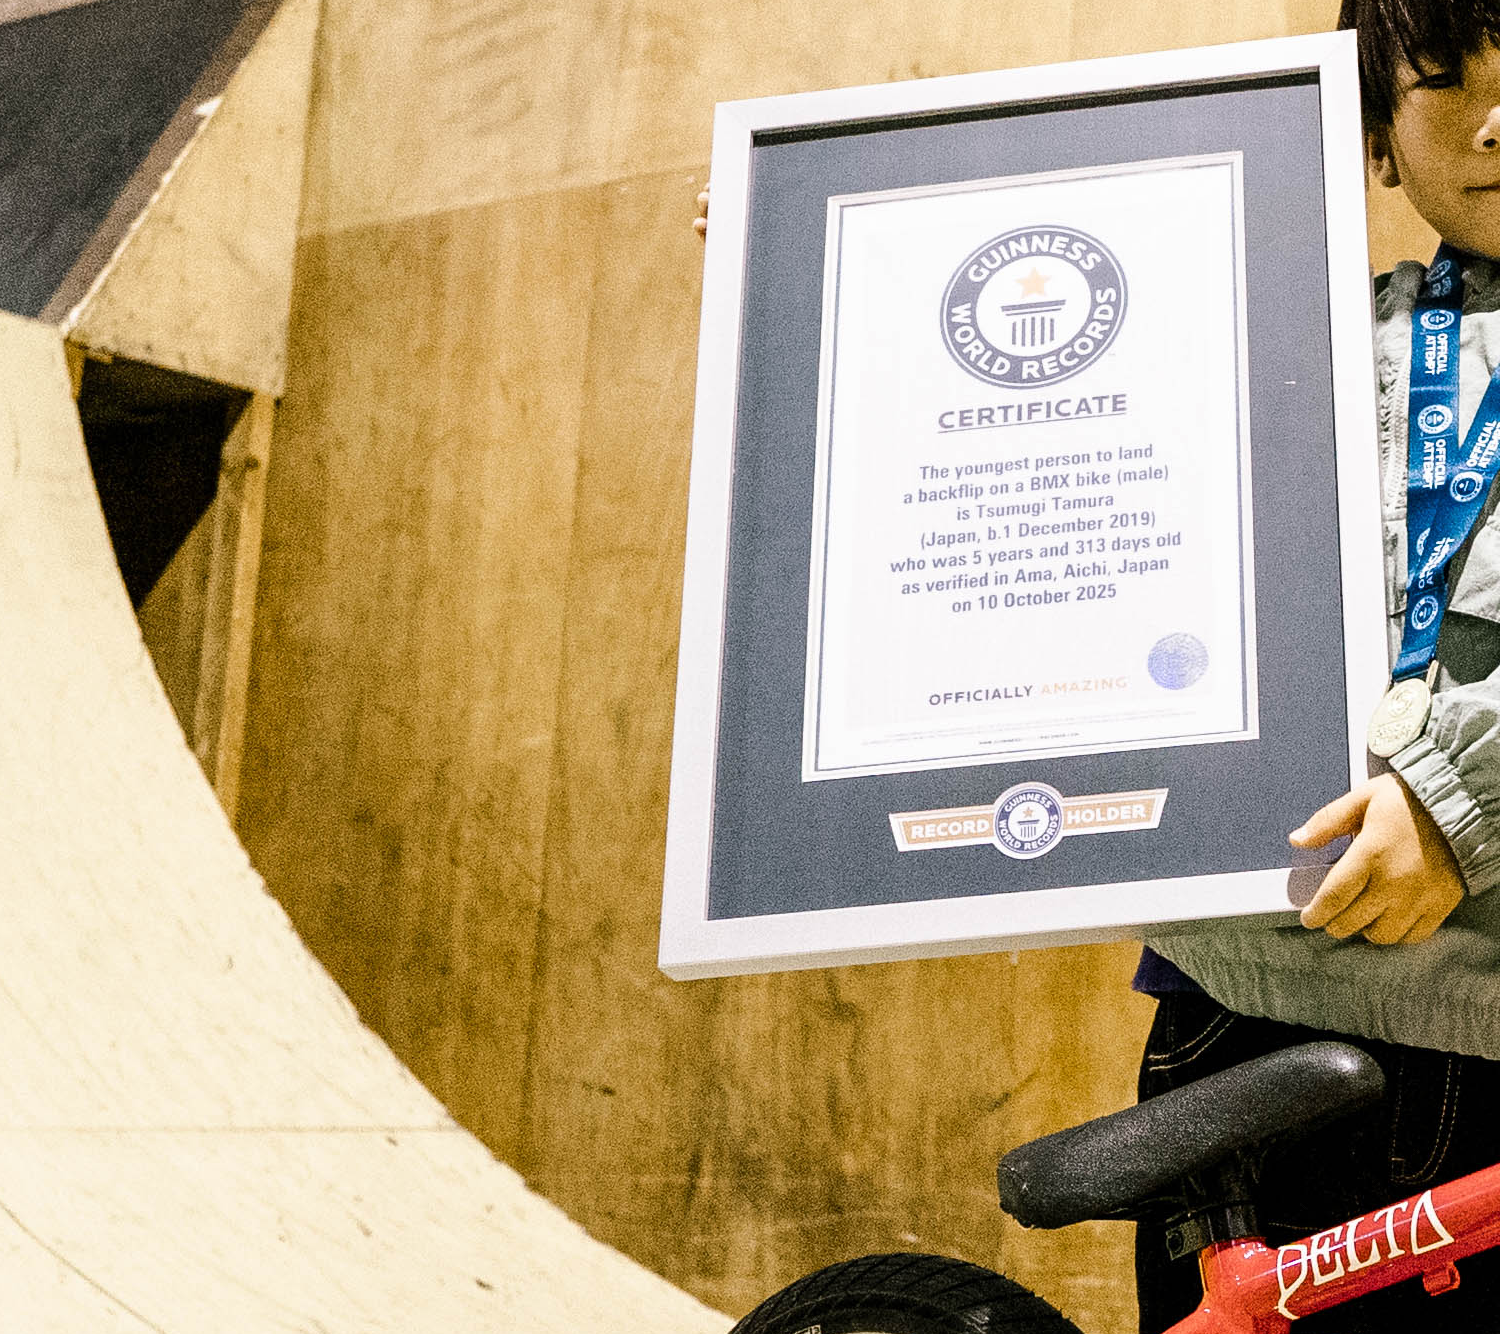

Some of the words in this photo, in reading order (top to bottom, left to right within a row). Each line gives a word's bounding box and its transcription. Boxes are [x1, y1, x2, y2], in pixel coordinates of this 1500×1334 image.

[968, 234, 1102, 282] GUINNESS
[951, 302, 1011, 376] WORLD
[1021, 287, 1117, 380] RECORDS
[1424, 334, 1435, 375] ATTEMPT
[1436, 333, 1447, 375] OFFICIAL
[937, 393, 1127, 429] CERTIFICATE
[920, 466, 949, 480] The
[955, 457, 1030, 479] youngest
[1035, 453, 1090, 470] person
[1096, 450, 1112, 462] to
[1119, 444, 1152, 460] land
[1466, 420, 1497, 467] OFFICIAL
[1423, 440, 1434, 489] ATTEMPT
[1434, 438, 1446, 489] OFFICIAL
[904, 493, 912, 504] a
[919, 485, 983, 503] backflip
[990, 483, 1009, 495] on
[1015, 481, 1024, 493] a
[1031, 475, 1070, 491] BMX
[1076, 471, 1110, 487] bike
[1117, 465, 1169, 485] (male)
[956, 507, 970, 521] is
[977, 498, 1046, 519] Tsumugi
[1052, 495, 1114, 511] Tamura
[920, 530, 981, 549] (Japan,
[988, 525, 1010, 541] b.1
[1019, 519, 1104, 537] December
[1110, 511, 1156, 529] 2019)
[890, 557, 926, 573] who
[932, 554, 966, 569] was
[973, 551, 982, 565] 5
[988, 547, 1033, 566] years
[1040, 542, 1069, 558] and
[1076, 538, 1106, 555] 313
[1112, 537, 1150, 555] days
[1156, 532, 1181, 547] old
[901, 581, 920, 595] as
[926, 573, 988, 592] verified
[994, 571, 1008, 585] in
[1015, 568, 1057, 583] Ama,
[1064, 561, 1110, 579] Aichi,
[1117, 558, 1169, 575] Japan
[952, 599, 971, 613] on
[978, 595, 998, 610] 10
[1004, 589, 1070, 608] October
[1076, 583, 1116, 601] 2025
[929, 685, 1034, 706] OFFICIALLY
[1041, 677, 1128, 695] AMAZING
[911, 819, 990, 839] RECORD
[1067, 805, 1147, 825] HOLDER
[1004, 793, 1054, 813] GUINNESS
[998, 818, 1022, 850] WORLD
[1023, 815, 1059, 850] RECORDS
[1275, 1190, 1454, 1320] DELTA
